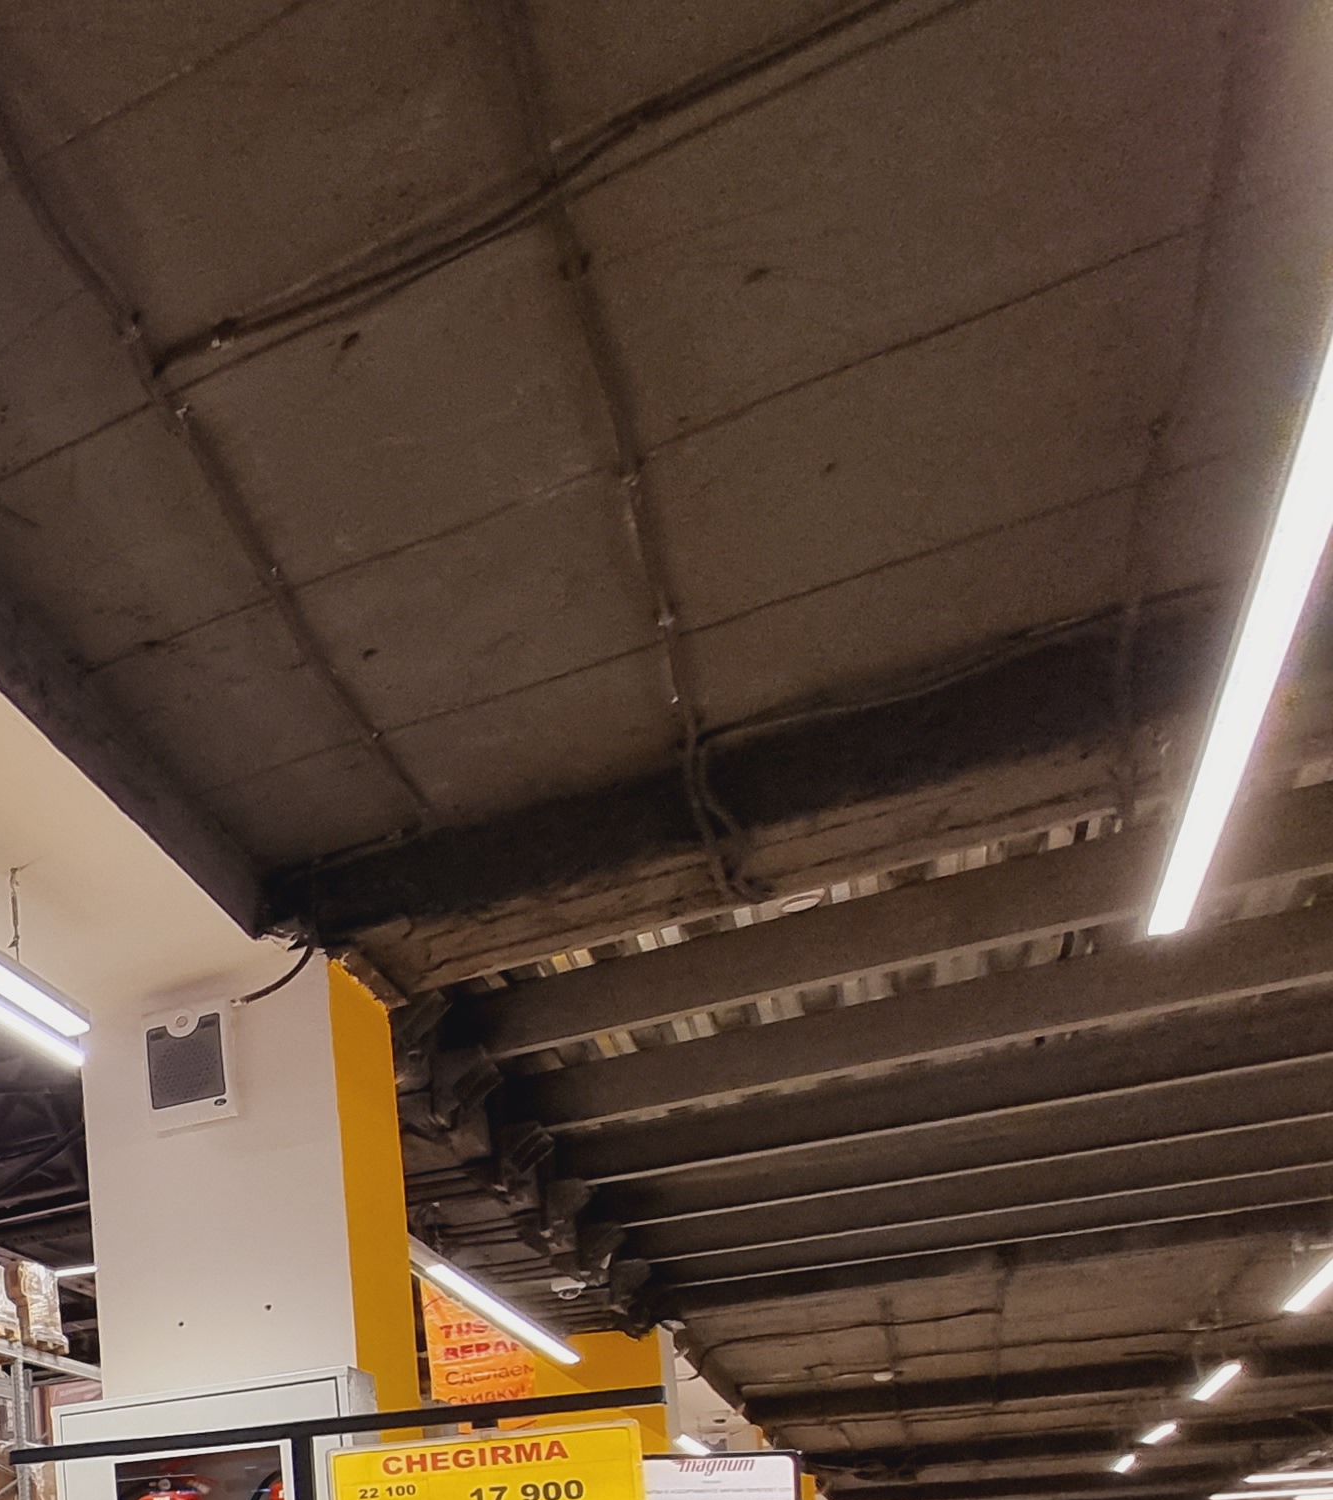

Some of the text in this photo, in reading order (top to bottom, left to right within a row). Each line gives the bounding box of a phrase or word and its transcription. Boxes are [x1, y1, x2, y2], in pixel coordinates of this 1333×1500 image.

[381, 1439, 569, 1476] CHEGIRMA
[672, 1458, 756, 1476] magnum
[358, 1487, 379, 1500] 22
[383, 1483, 417, 1498] 100
